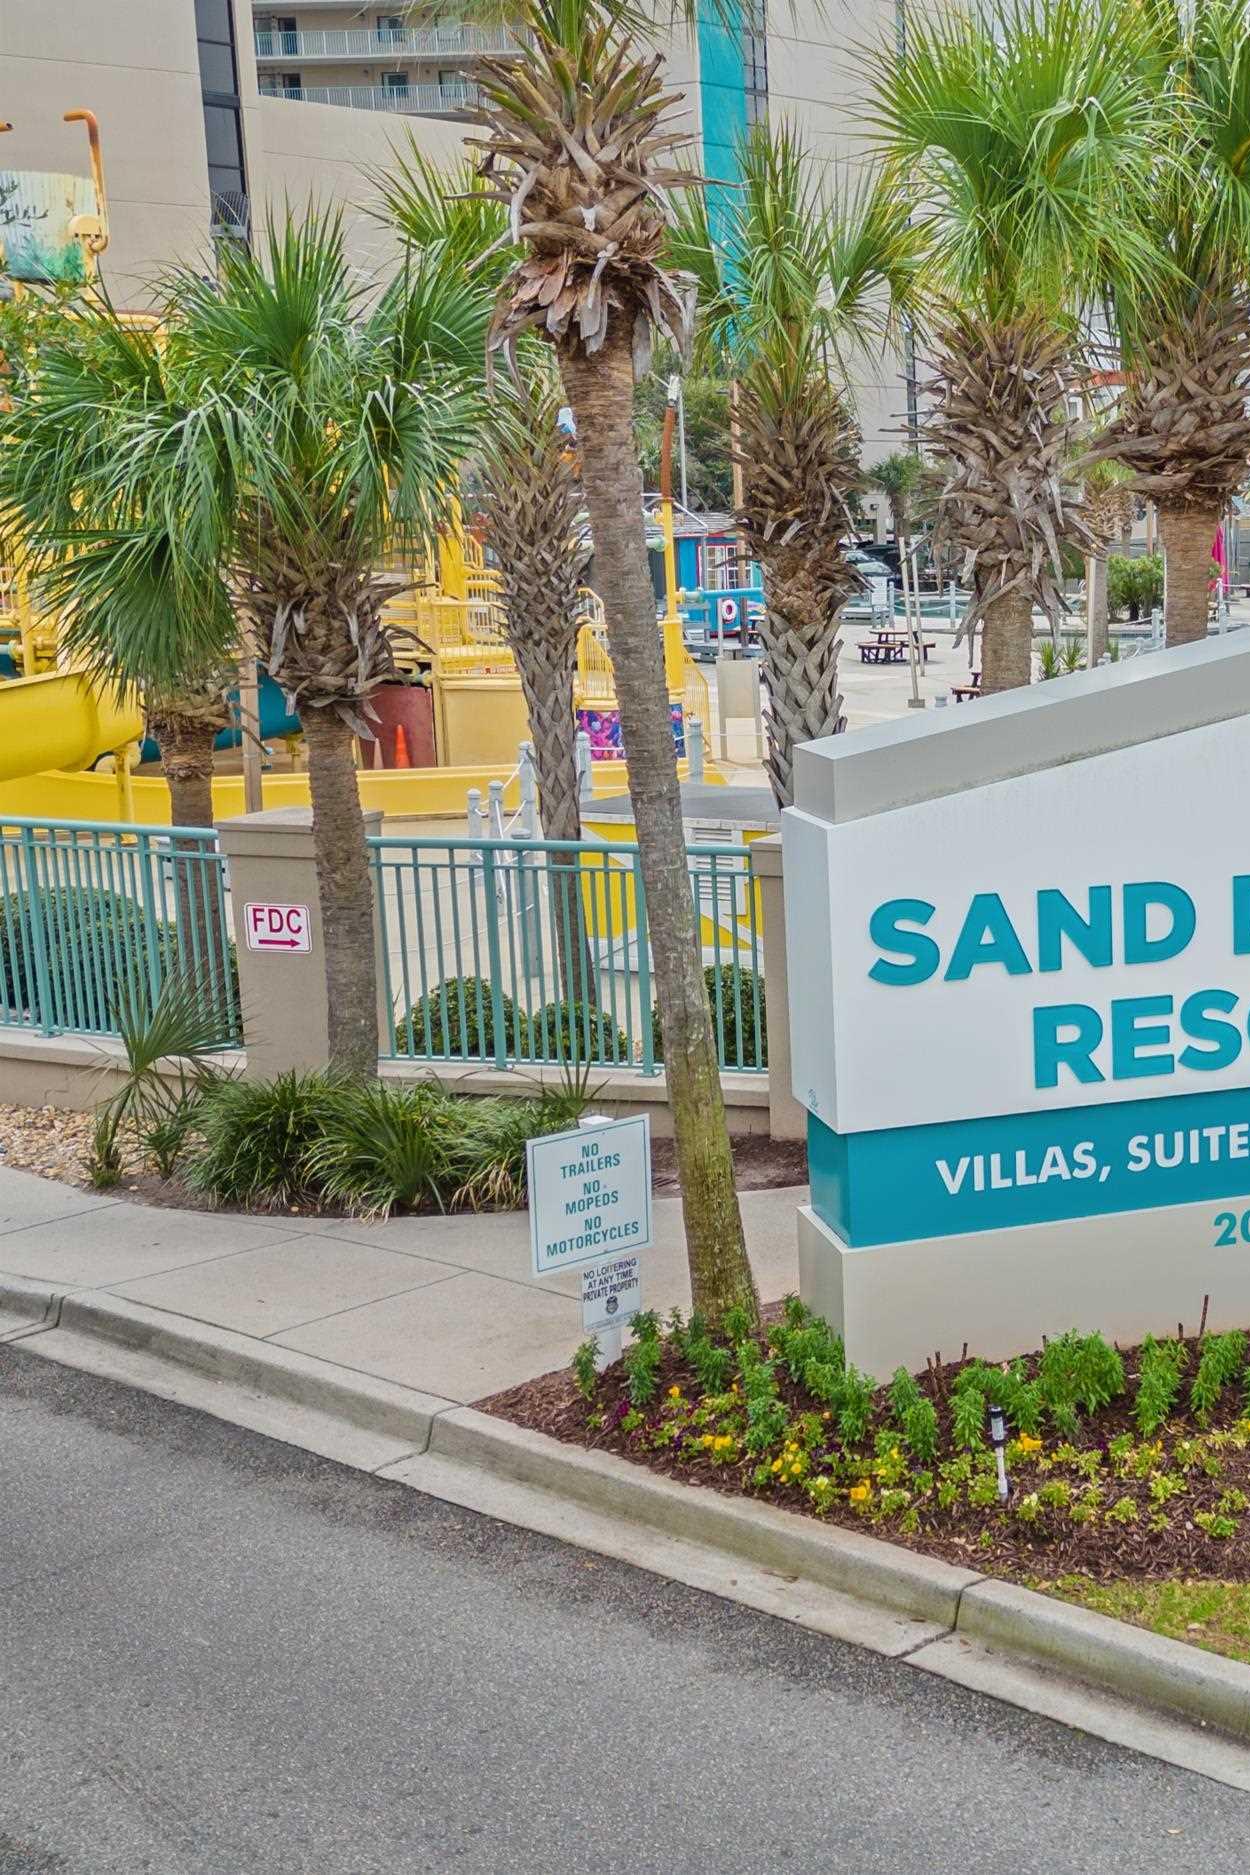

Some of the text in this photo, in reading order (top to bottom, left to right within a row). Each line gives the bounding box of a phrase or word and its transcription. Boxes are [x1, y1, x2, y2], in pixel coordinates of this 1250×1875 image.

[252, 907, 302, 935] FDC
[867, 880, 1197, 988] SAND
[581, 1142, 599, 1159] NO
[560, 1152, 621, 1179] TRAILERS
[934, 1140, 1112, 1196] VILLAS,
[583, 1179, 601, 1195] NO
[565, 1190, 619, 1216] MOPEDS
[584, 1215, 602, 1232] NO
[546, 1221, 640, 1258] MOTORCYCLES
[583, 1270, 595, 1281] NO
[587, 1268, 634, 1290] AT ANY TIME
[583, 1277, 639, 1303] PRIVATE PROPERTY
